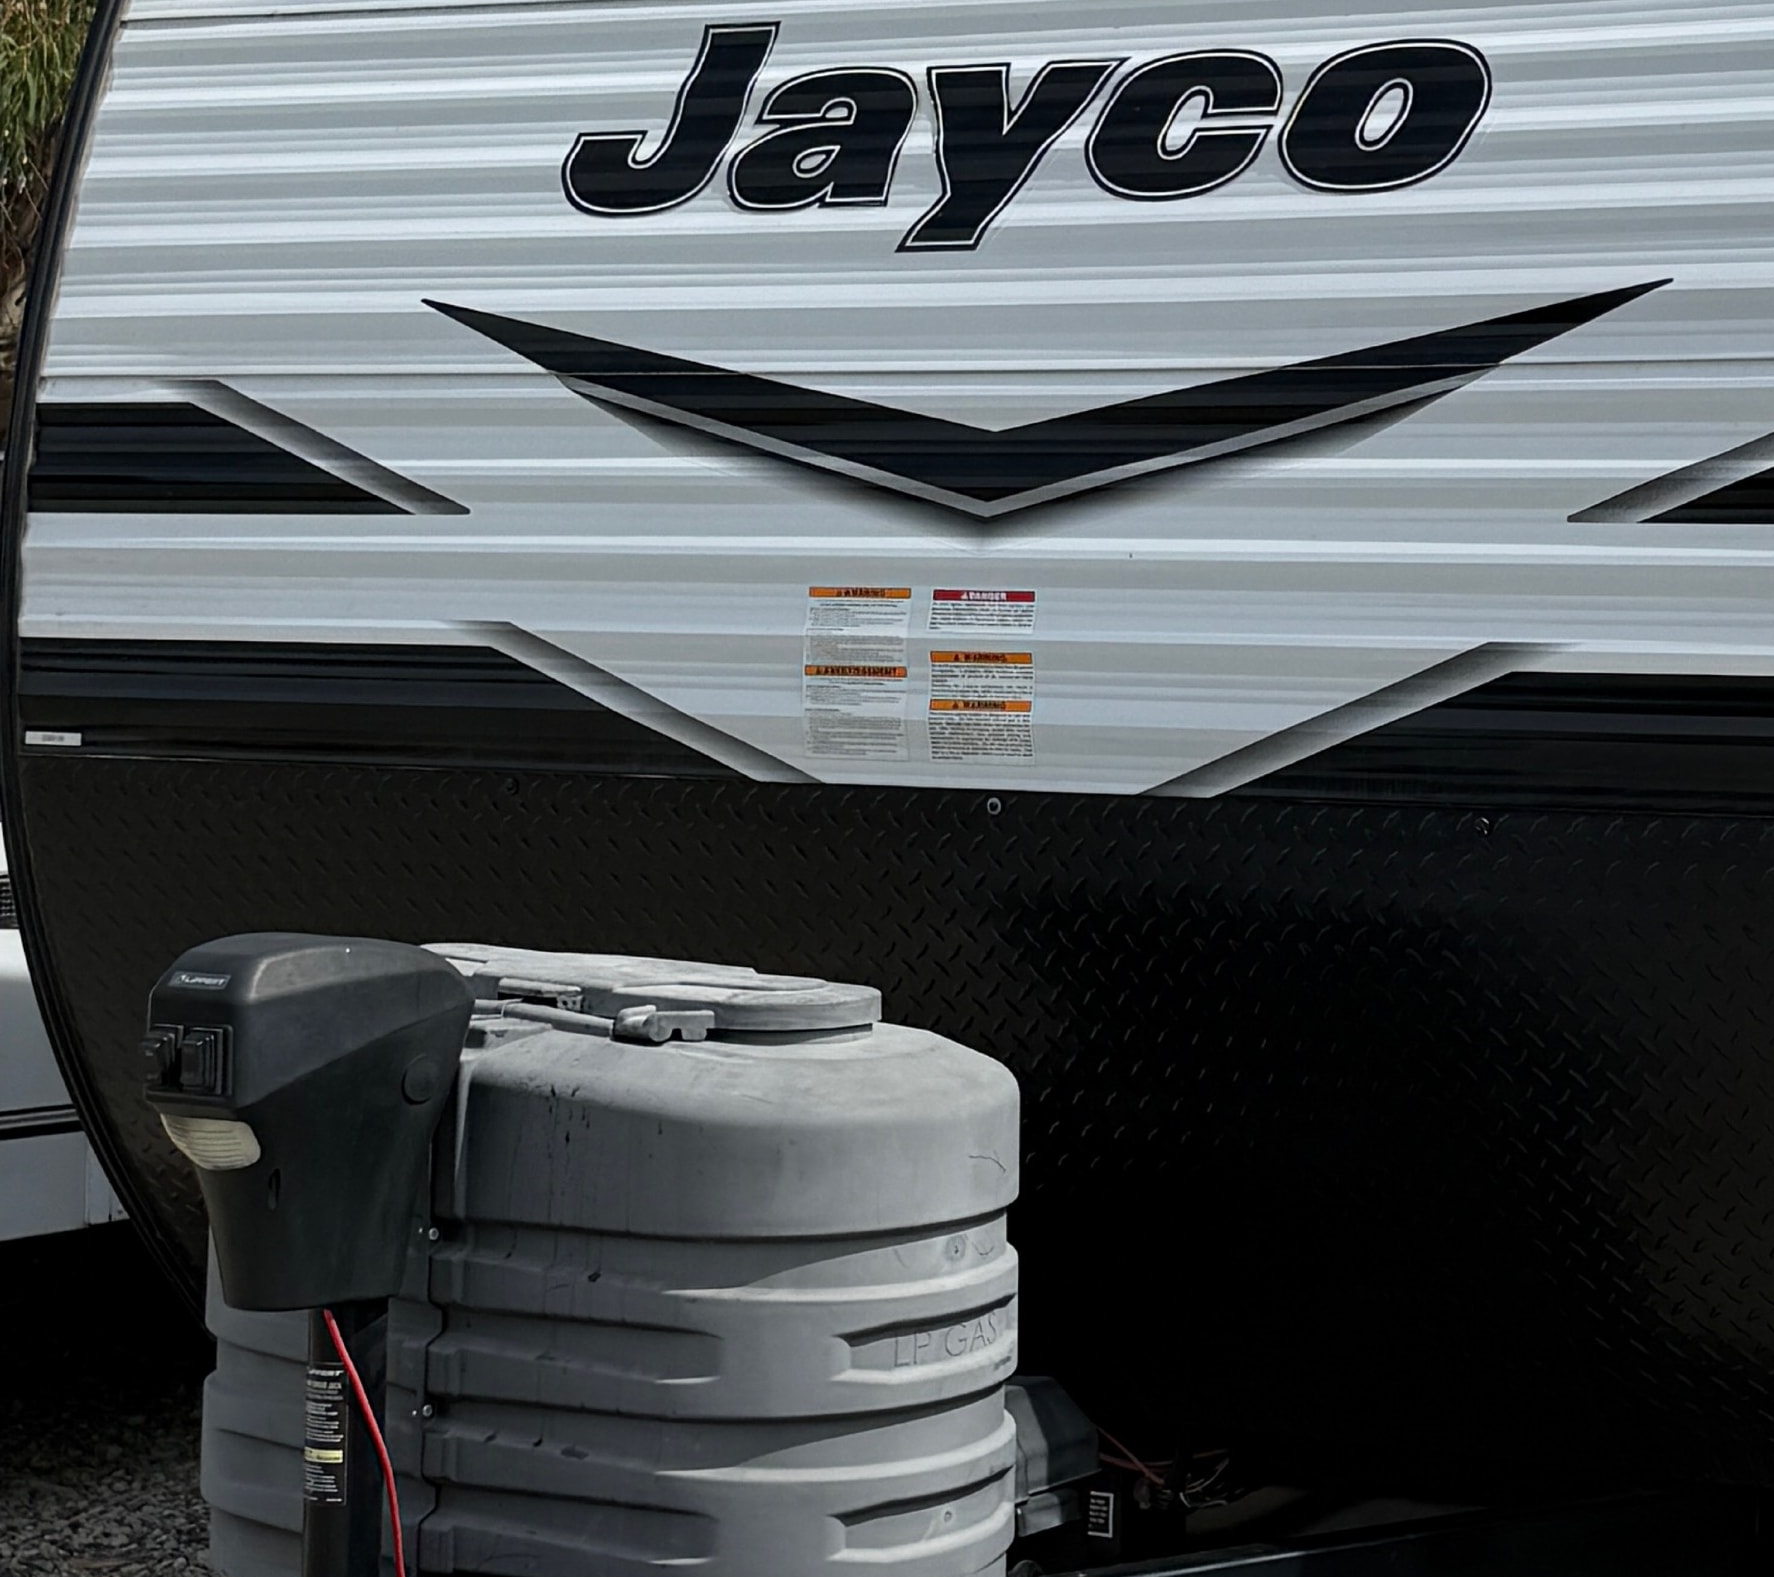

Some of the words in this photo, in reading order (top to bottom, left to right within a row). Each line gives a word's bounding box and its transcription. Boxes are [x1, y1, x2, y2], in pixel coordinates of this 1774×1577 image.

[561, 21, 1493, 253] Jayco
[968, 591, 1007, 601] DANGER
[894, 1331, 931, 1367] LP
[944, 1311, 997, 1357] GAS
